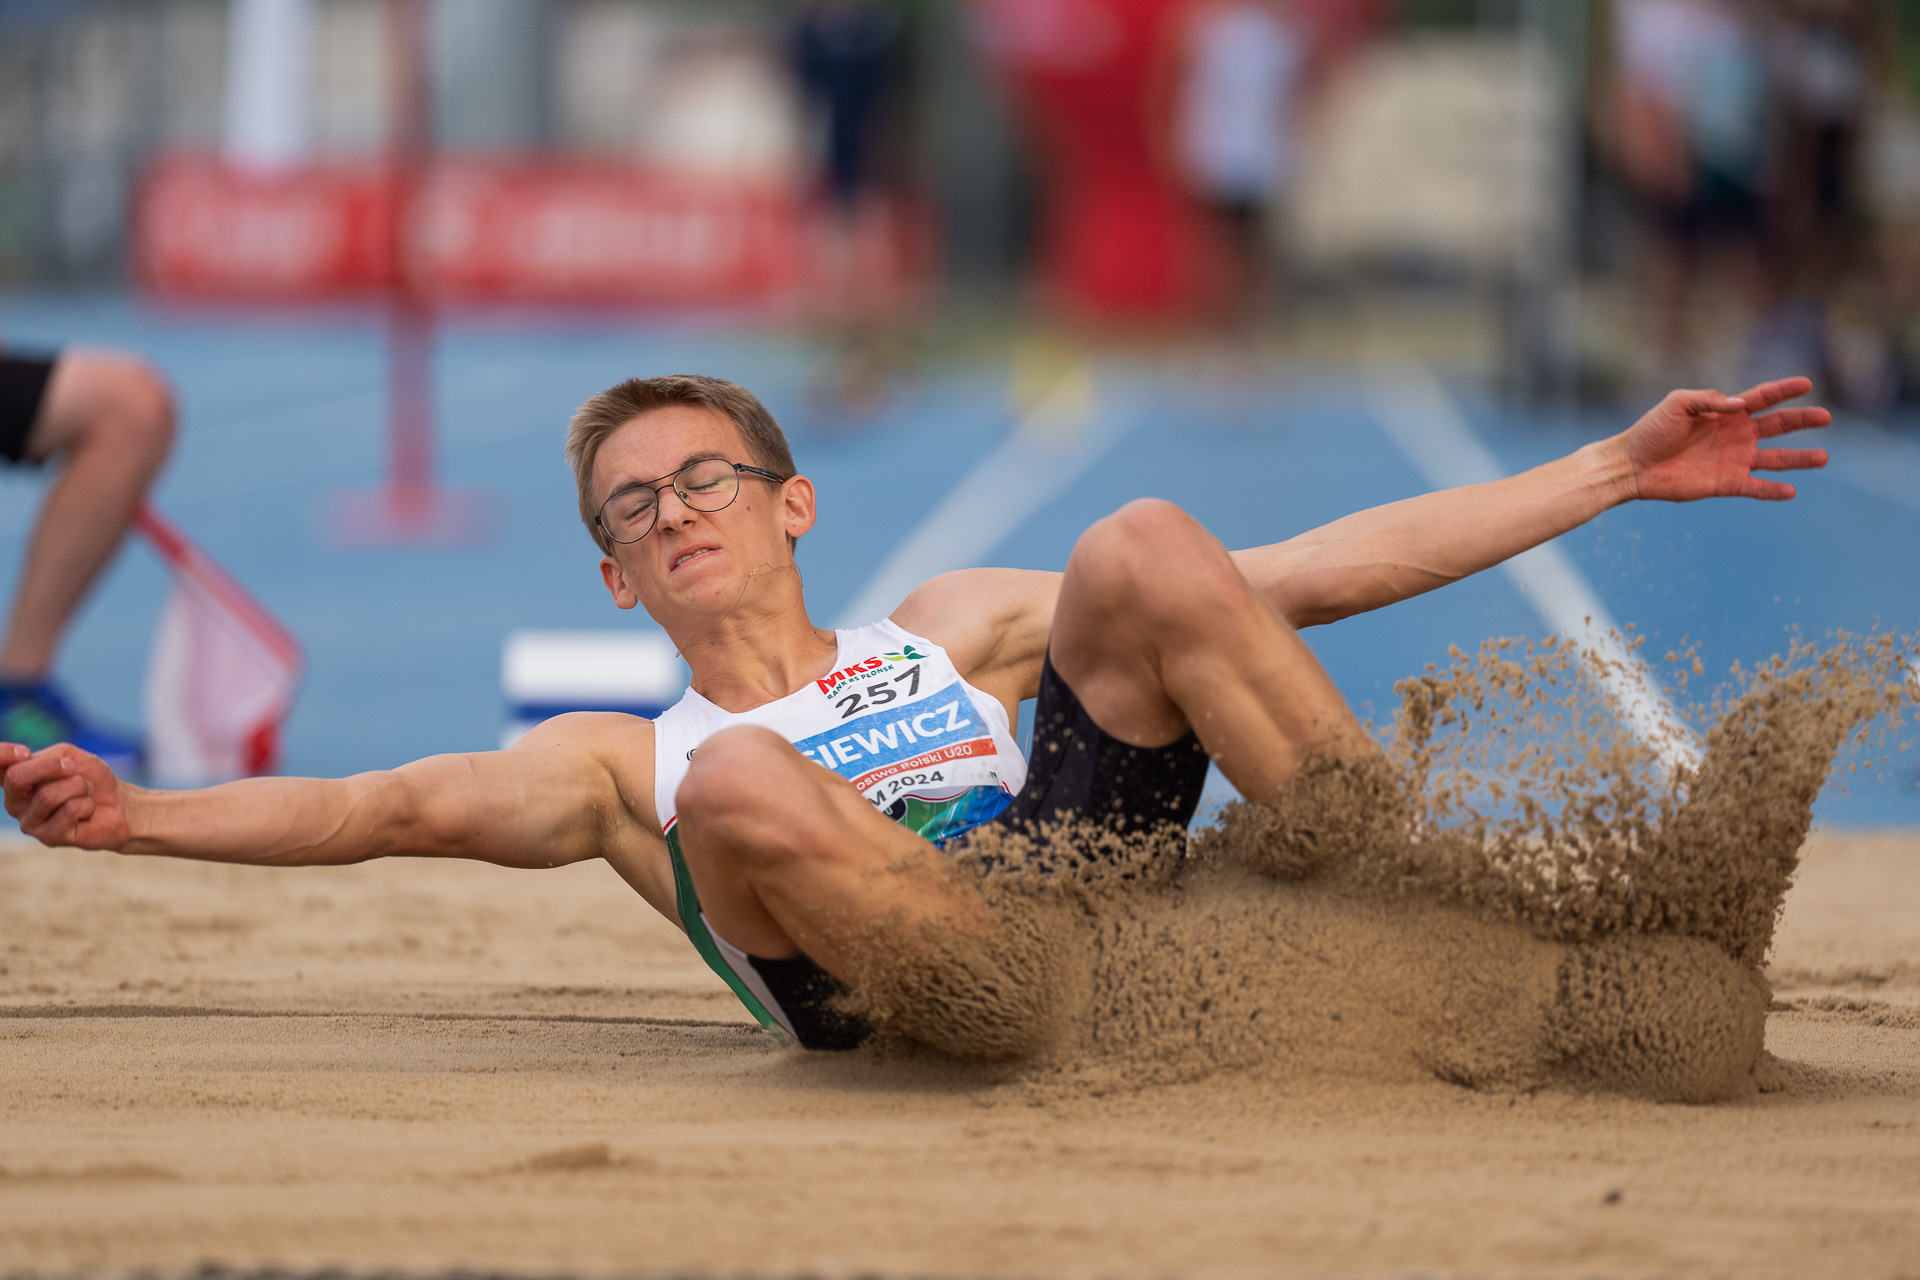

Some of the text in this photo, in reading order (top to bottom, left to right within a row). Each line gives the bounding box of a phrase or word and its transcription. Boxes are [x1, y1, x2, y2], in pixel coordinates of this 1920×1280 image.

[816, 656, 883, 695] MKS
[827, 680, 848, 700] BANK
[860, 664, 895, 680] PŁOŃSK
[835, 663, 920, 719] 257
[901, 751, 942, 770] Polski
[944, 744, 973, 758] U20
[888, 770, 945, 795] 2024
